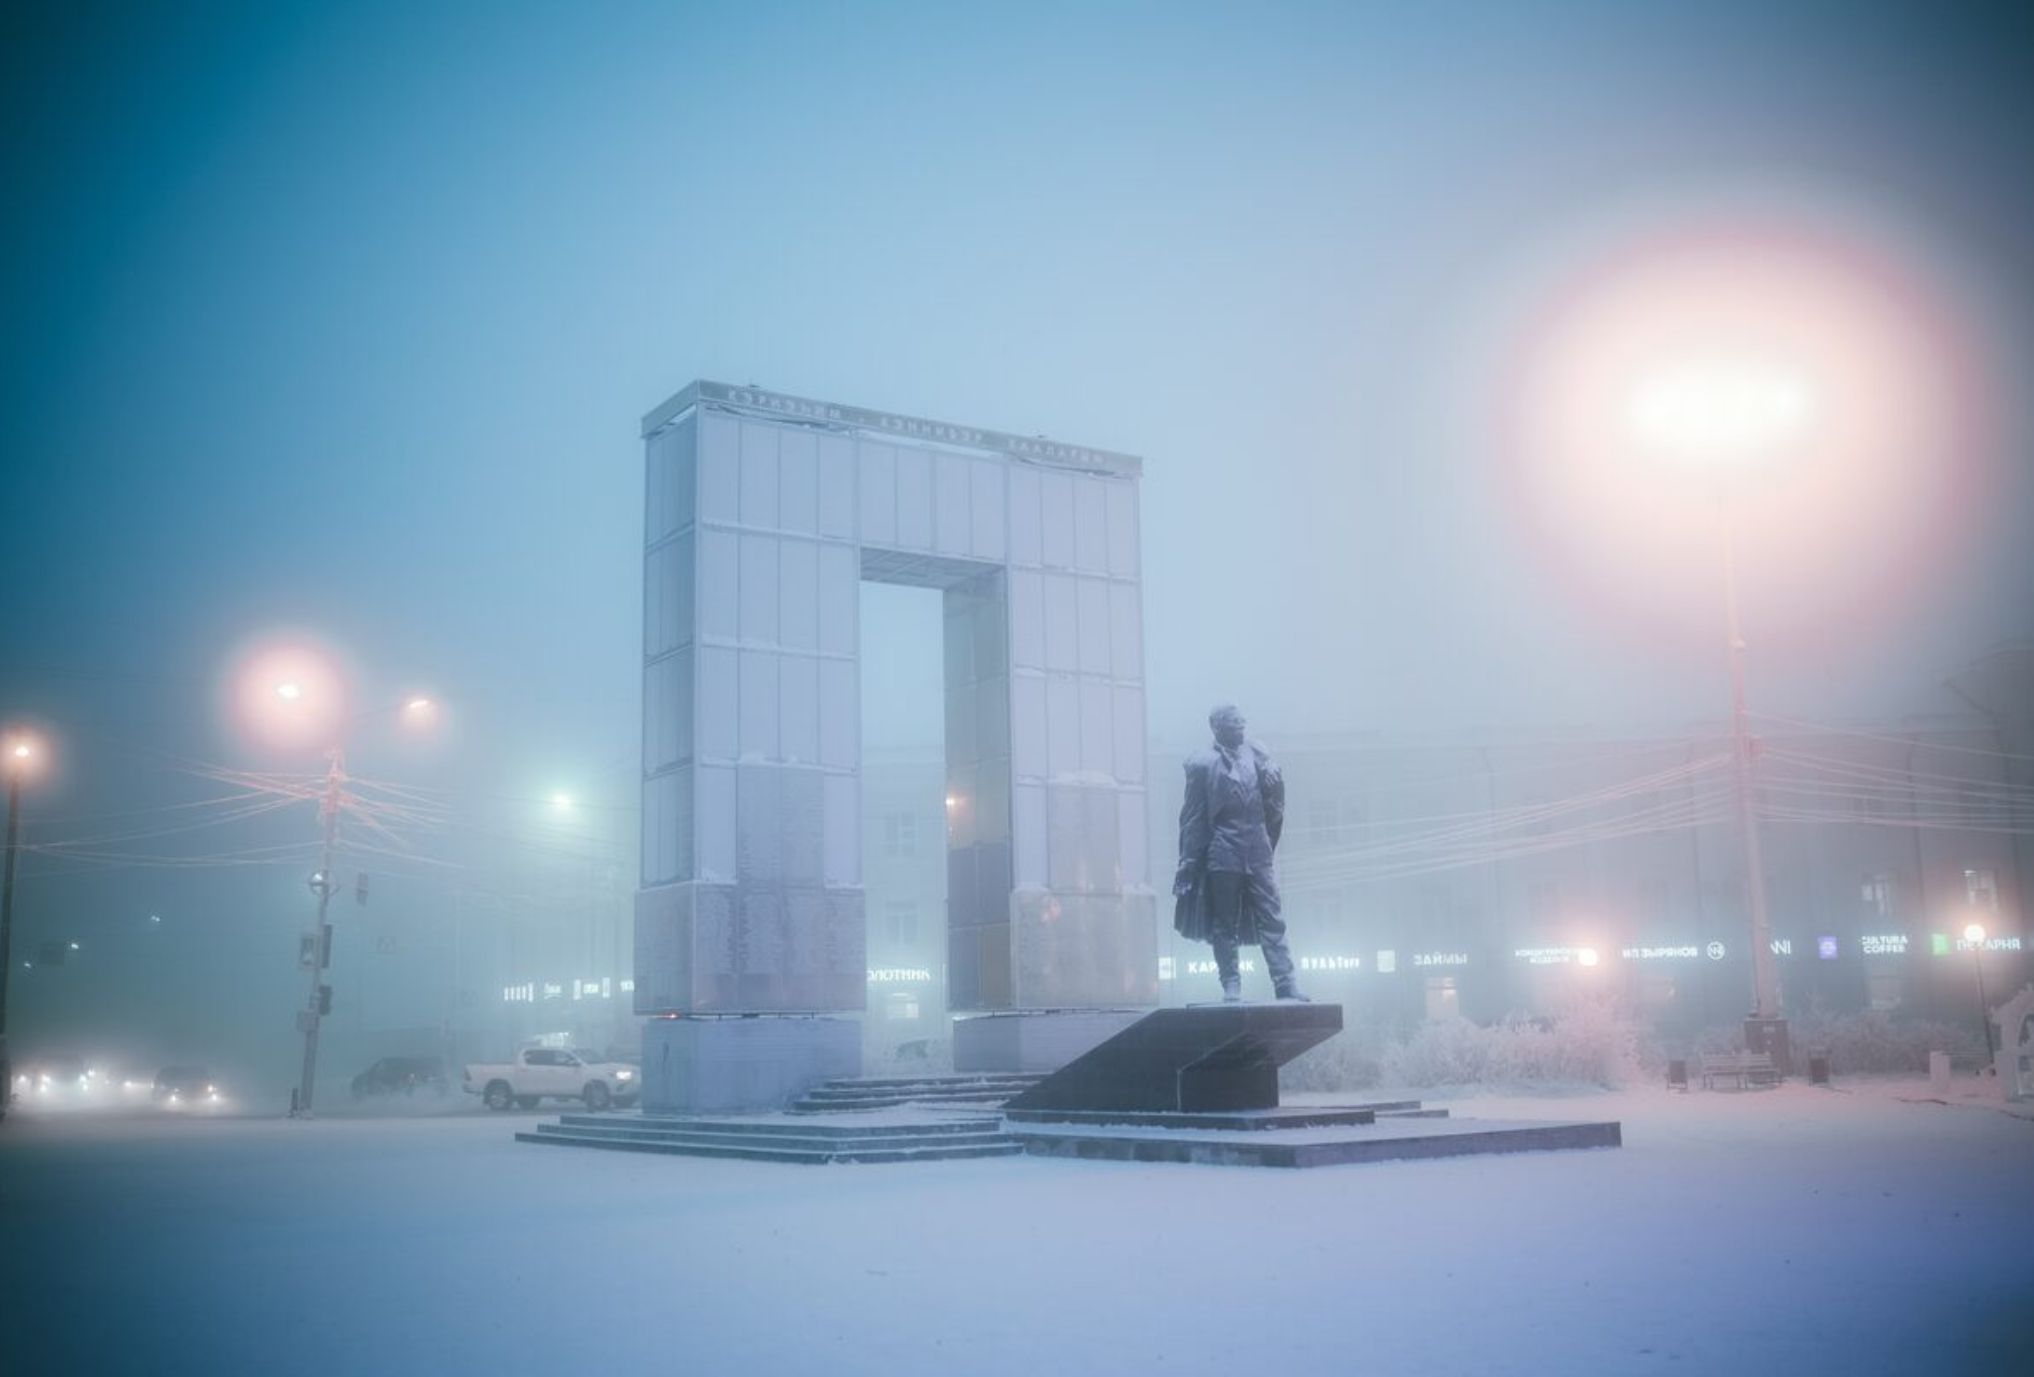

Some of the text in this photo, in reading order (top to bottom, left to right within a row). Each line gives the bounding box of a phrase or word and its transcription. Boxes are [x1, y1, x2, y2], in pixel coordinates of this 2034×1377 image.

[1861, 935, 1908, 944] CULTURA
[1863, 944, 1906, 954] COFFEE
[1413, 951, 1468, 966] ЗАЙМЫ
